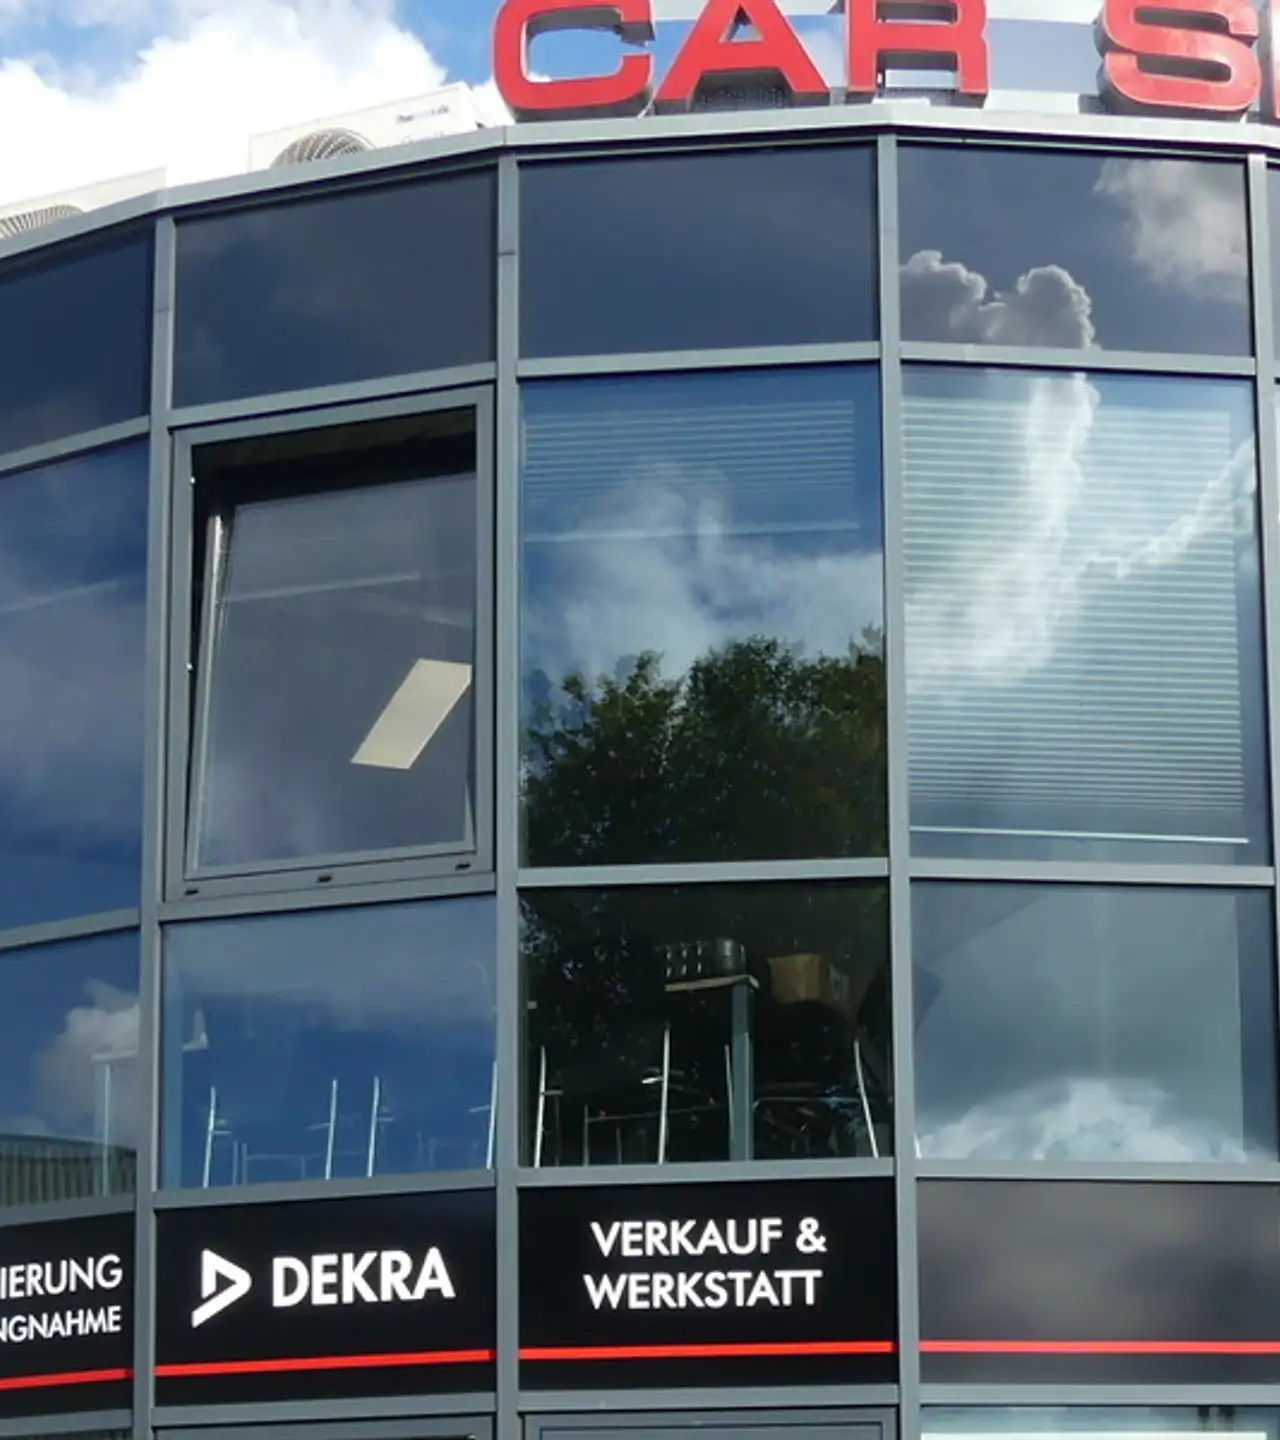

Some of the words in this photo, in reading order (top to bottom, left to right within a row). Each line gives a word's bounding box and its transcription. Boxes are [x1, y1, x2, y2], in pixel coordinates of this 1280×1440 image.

[490, 0, 990, 111] CAR
[589, 1217, 784, 1258] VERKAUF
[794, 1216, 828, 1254] &
[271, 1246, 457, 1308] DEKRA
[582, 1268, 823, 1311] WERKSTATT
